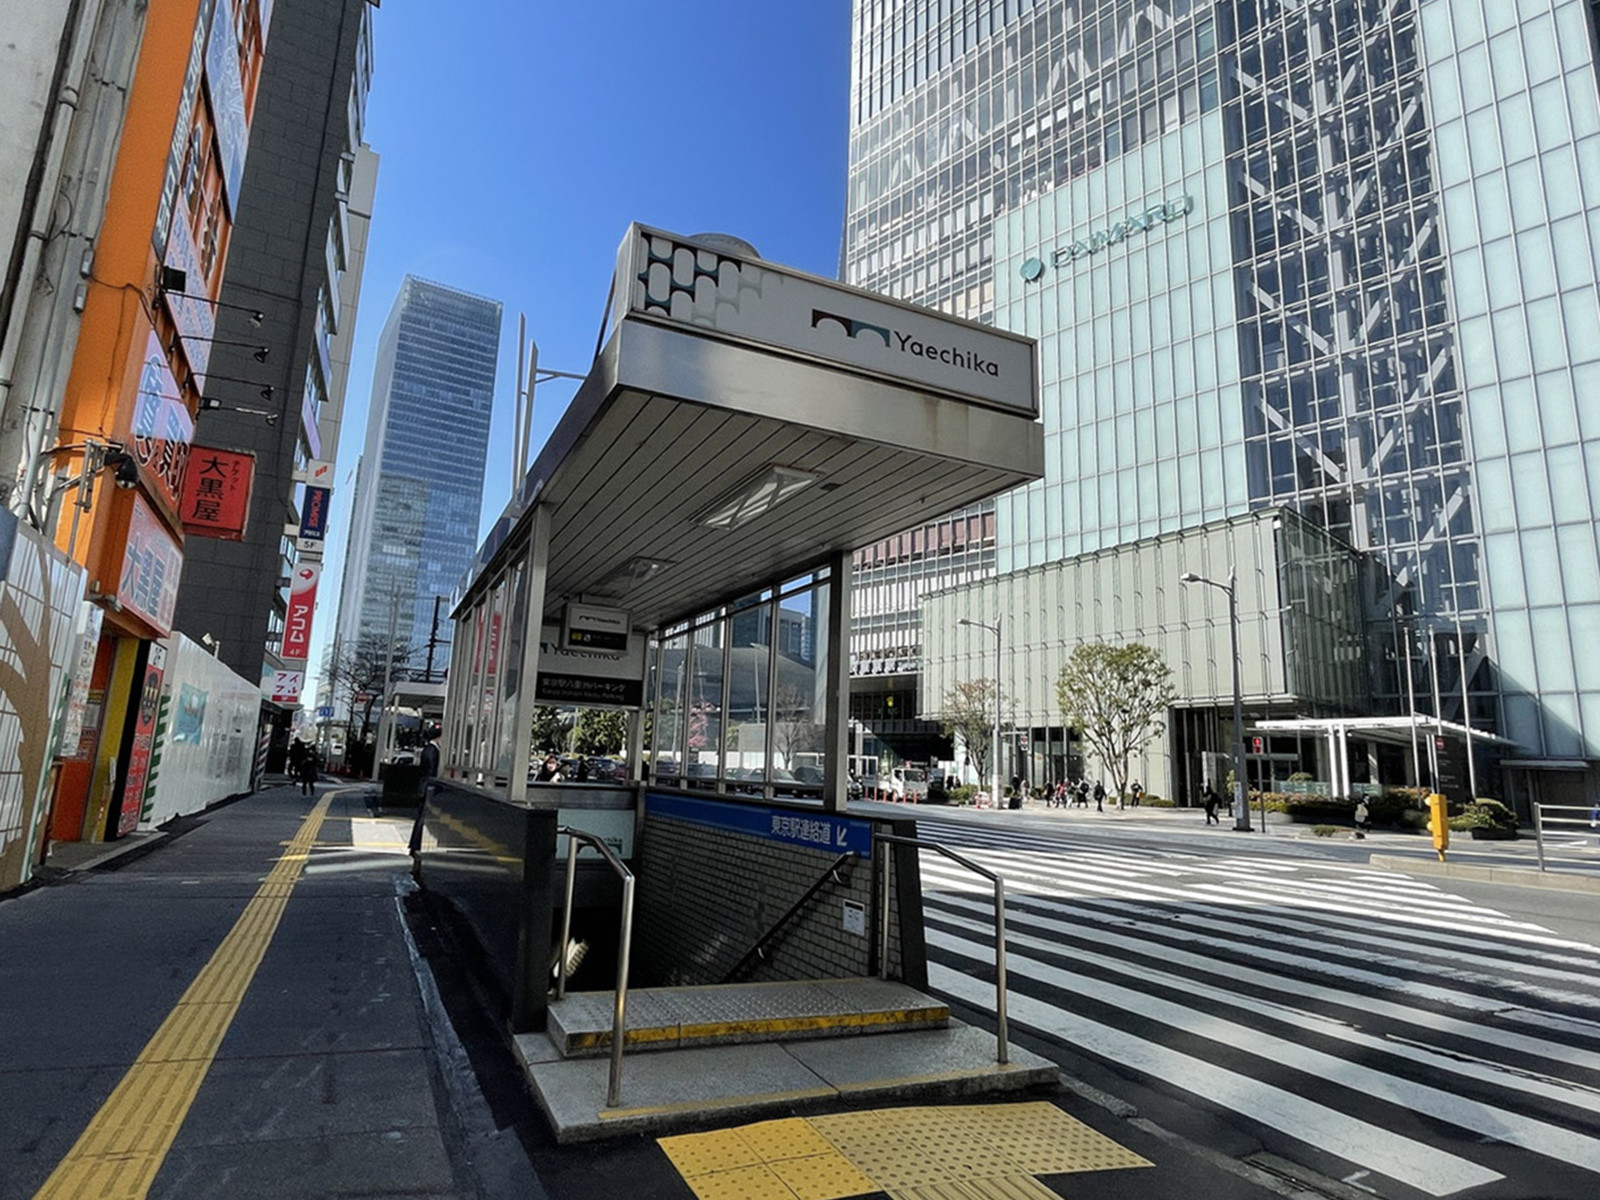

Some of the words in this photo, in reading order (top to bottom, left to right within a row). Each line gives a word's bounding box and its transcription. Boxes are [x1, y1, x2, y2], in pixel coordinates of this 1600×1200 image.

[894, 331, 999, 377] Yaechika
[192, 455, 229, 522] 大黒屋
[304, 541, 316, 549] 5F
[290, 604, 309, 643] アコム
